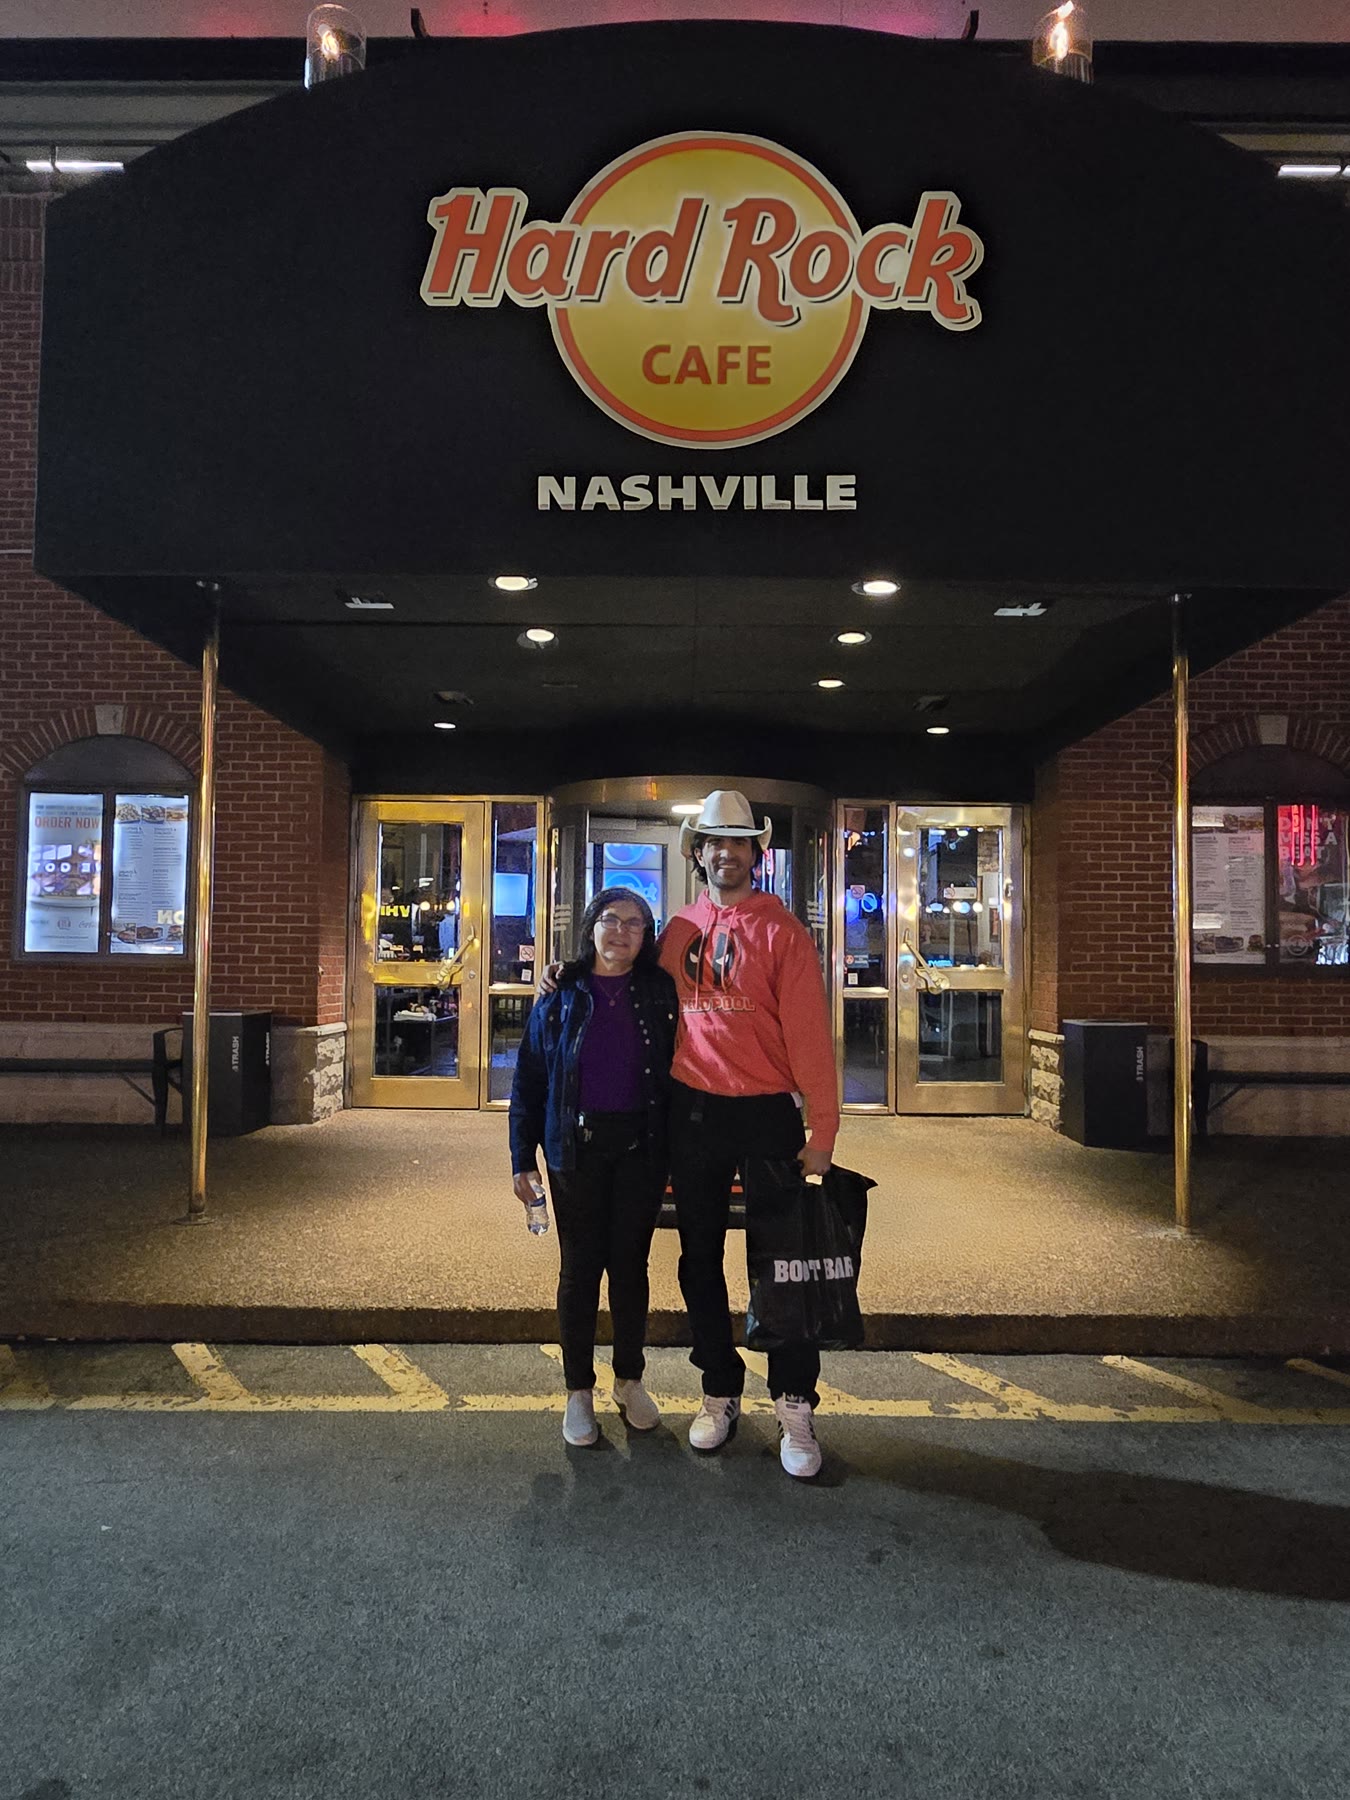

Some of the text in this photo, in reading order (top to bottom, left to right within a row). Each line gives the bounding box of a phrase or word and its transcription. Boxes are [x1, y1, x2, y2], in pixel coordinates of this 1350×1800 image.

[426, 193, 976, 325] Hard Rock
[641, 344, 772, 386] CAFE
[537, 474, 857, 511] NASHVILLE
[34, 816, 100, 829] ORDER NOW
[231, 1035, 239, 1065] TRASH
[1136, 1046, 1144, 1075] TRASH
